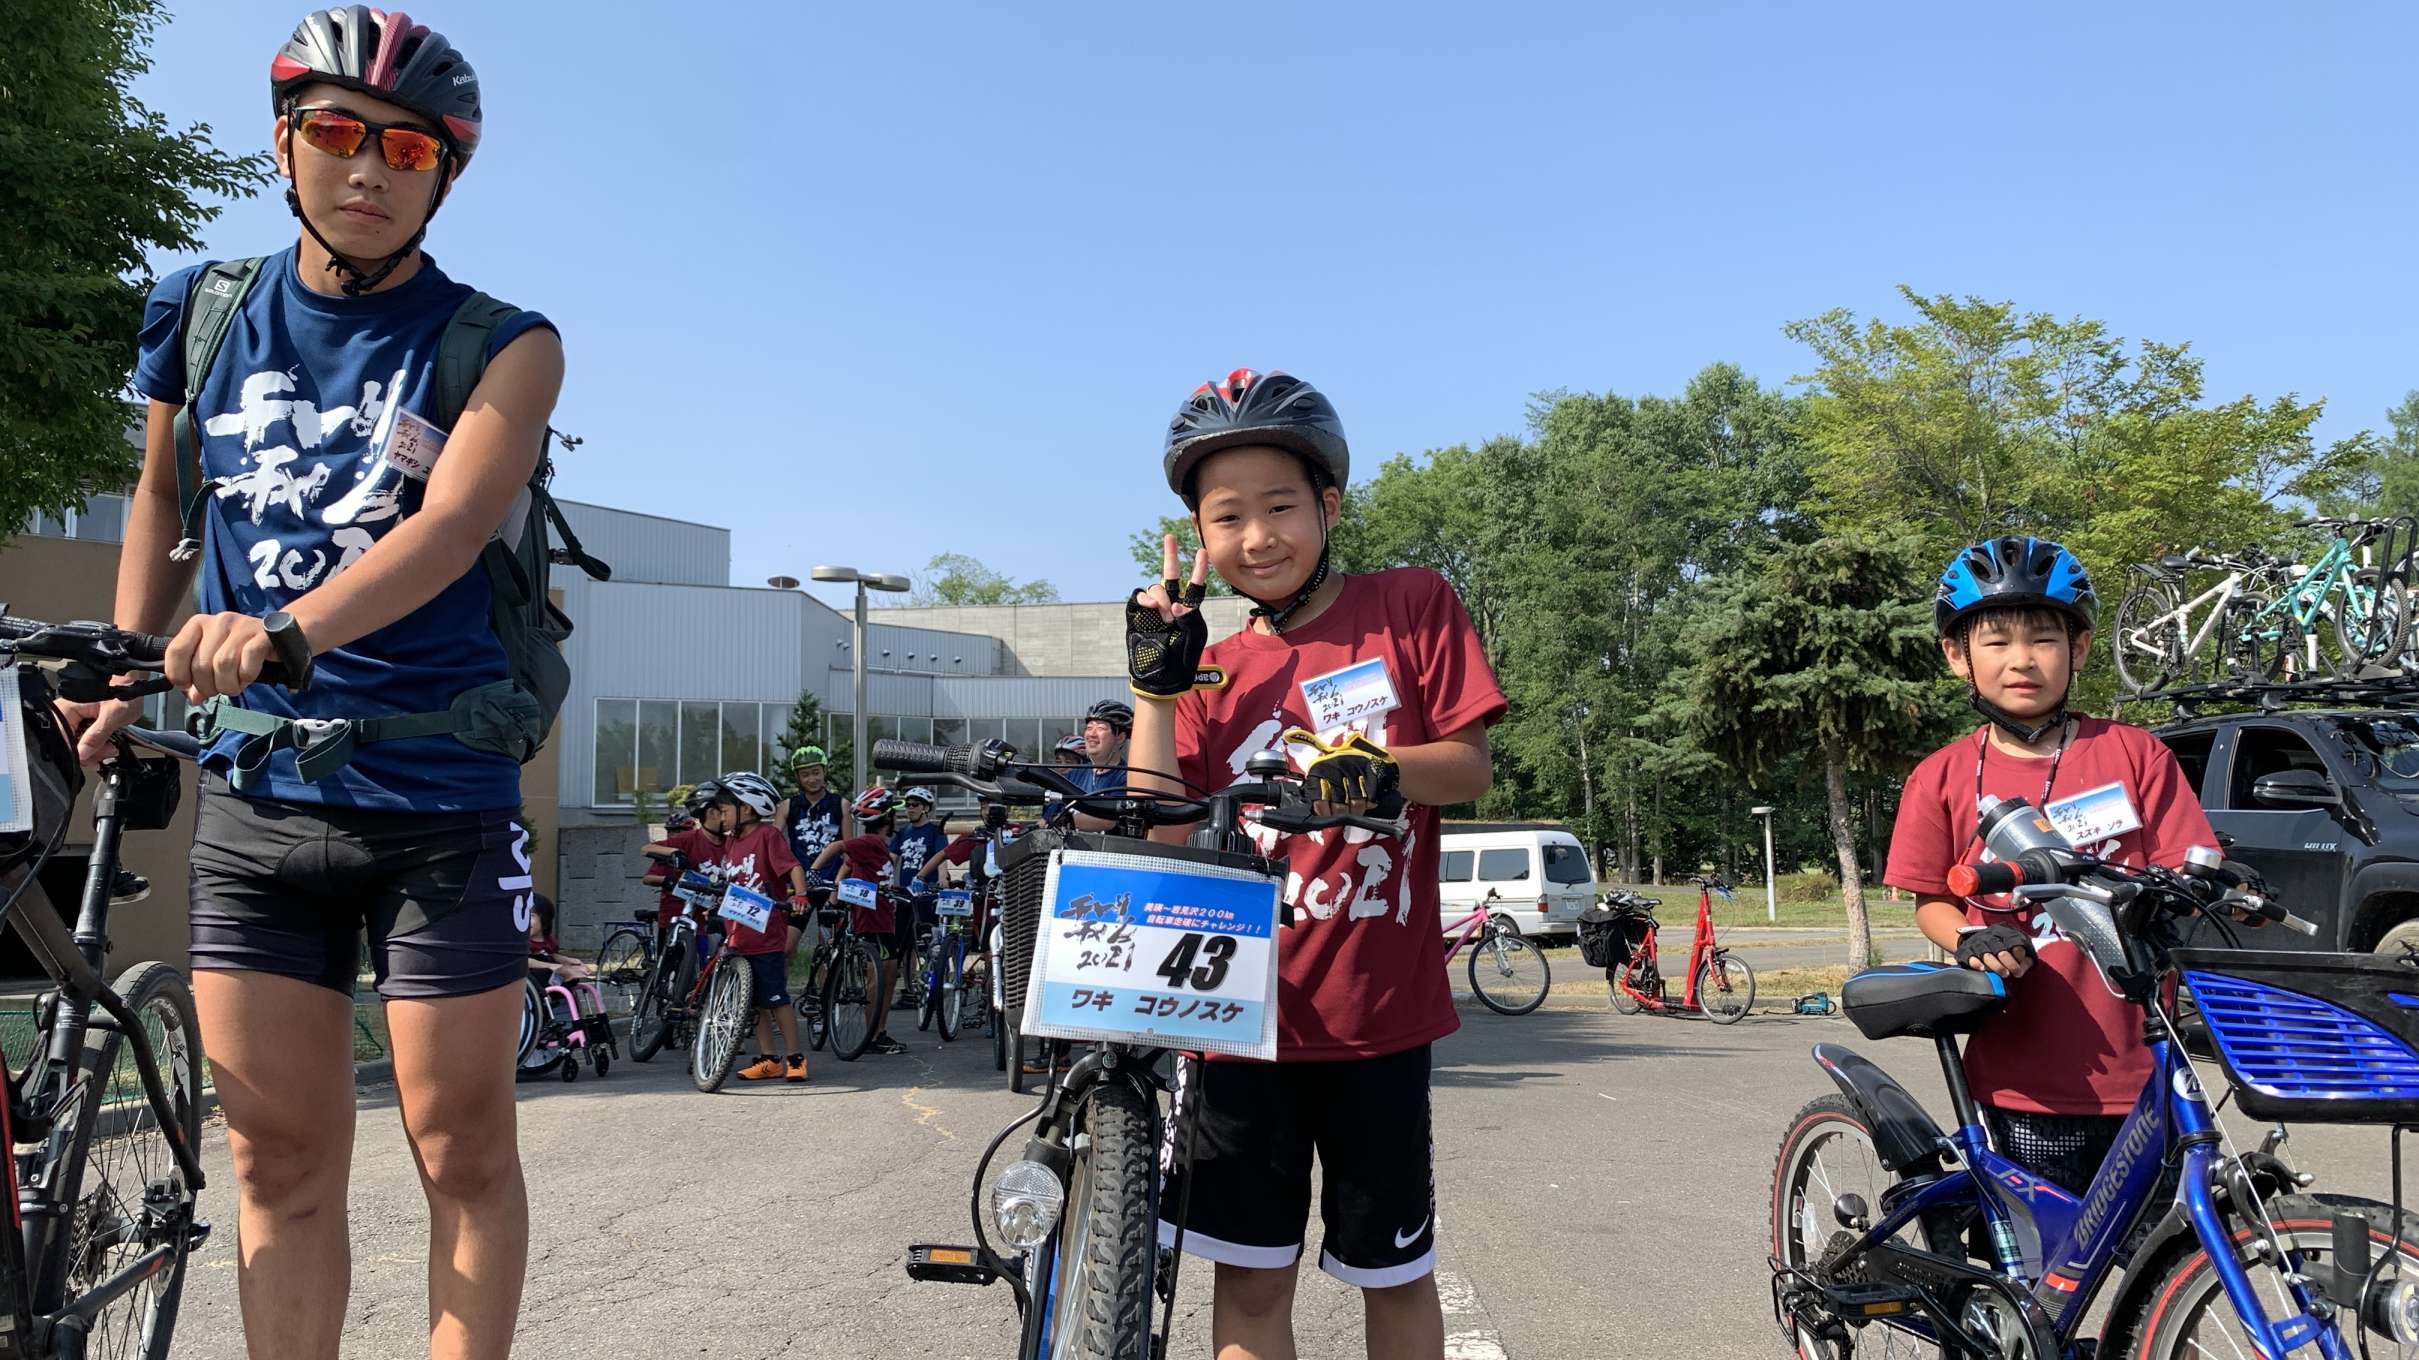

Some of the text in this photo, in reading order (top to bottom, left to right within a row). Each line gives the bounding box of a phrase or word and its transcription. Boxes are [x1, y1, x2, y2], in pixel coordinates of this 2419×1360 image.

[746, 905, 761, 917] 12
[1155, 932, 1237, 991] 43
[1071, 988, 1244, 1023] ワキ コウノスケ
[2074, 1101, 2160, 1252] BRIDGESTONE
